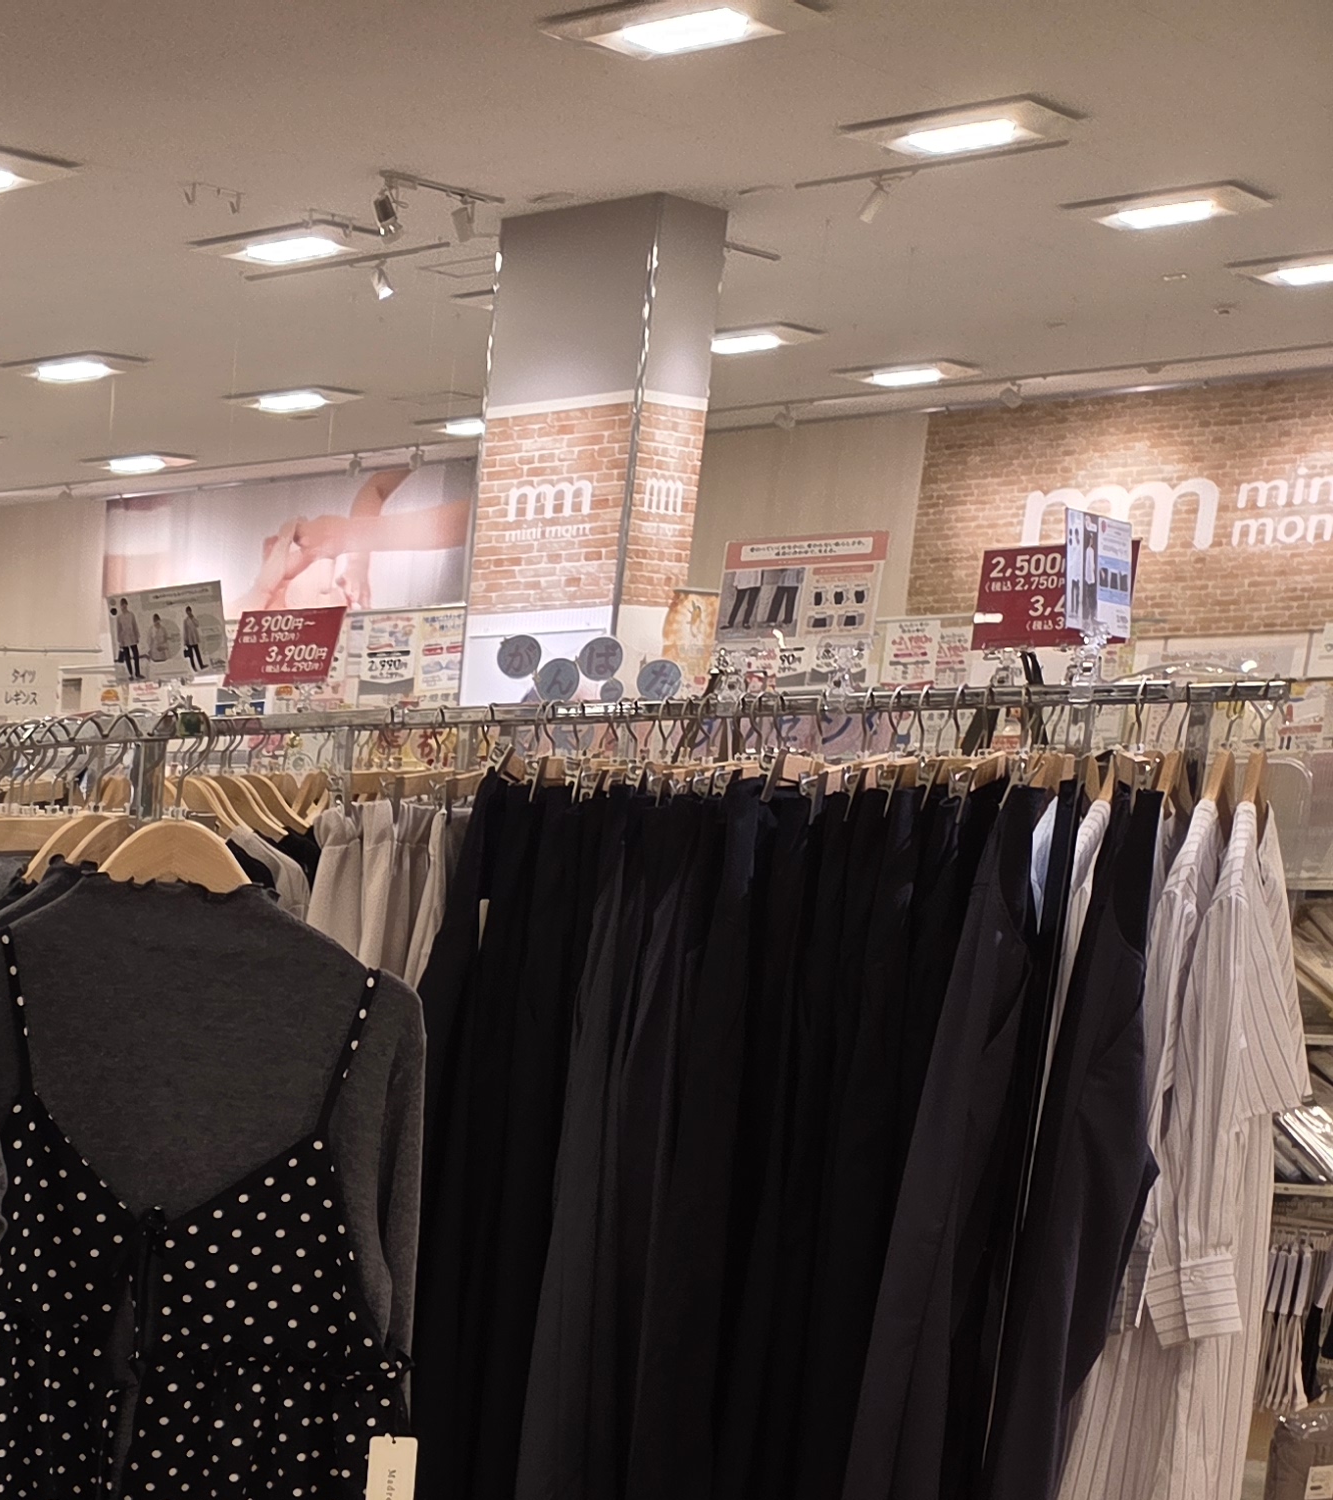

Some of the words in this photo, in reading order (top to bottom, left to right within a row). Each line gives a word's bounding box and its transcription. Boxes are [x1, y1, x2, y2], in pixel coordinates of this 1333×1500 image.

[989, 553, 1066, 578] 2,500
[265, 645, 329, 662] 3,900円
[4, 692, 38, 705] レギンス
